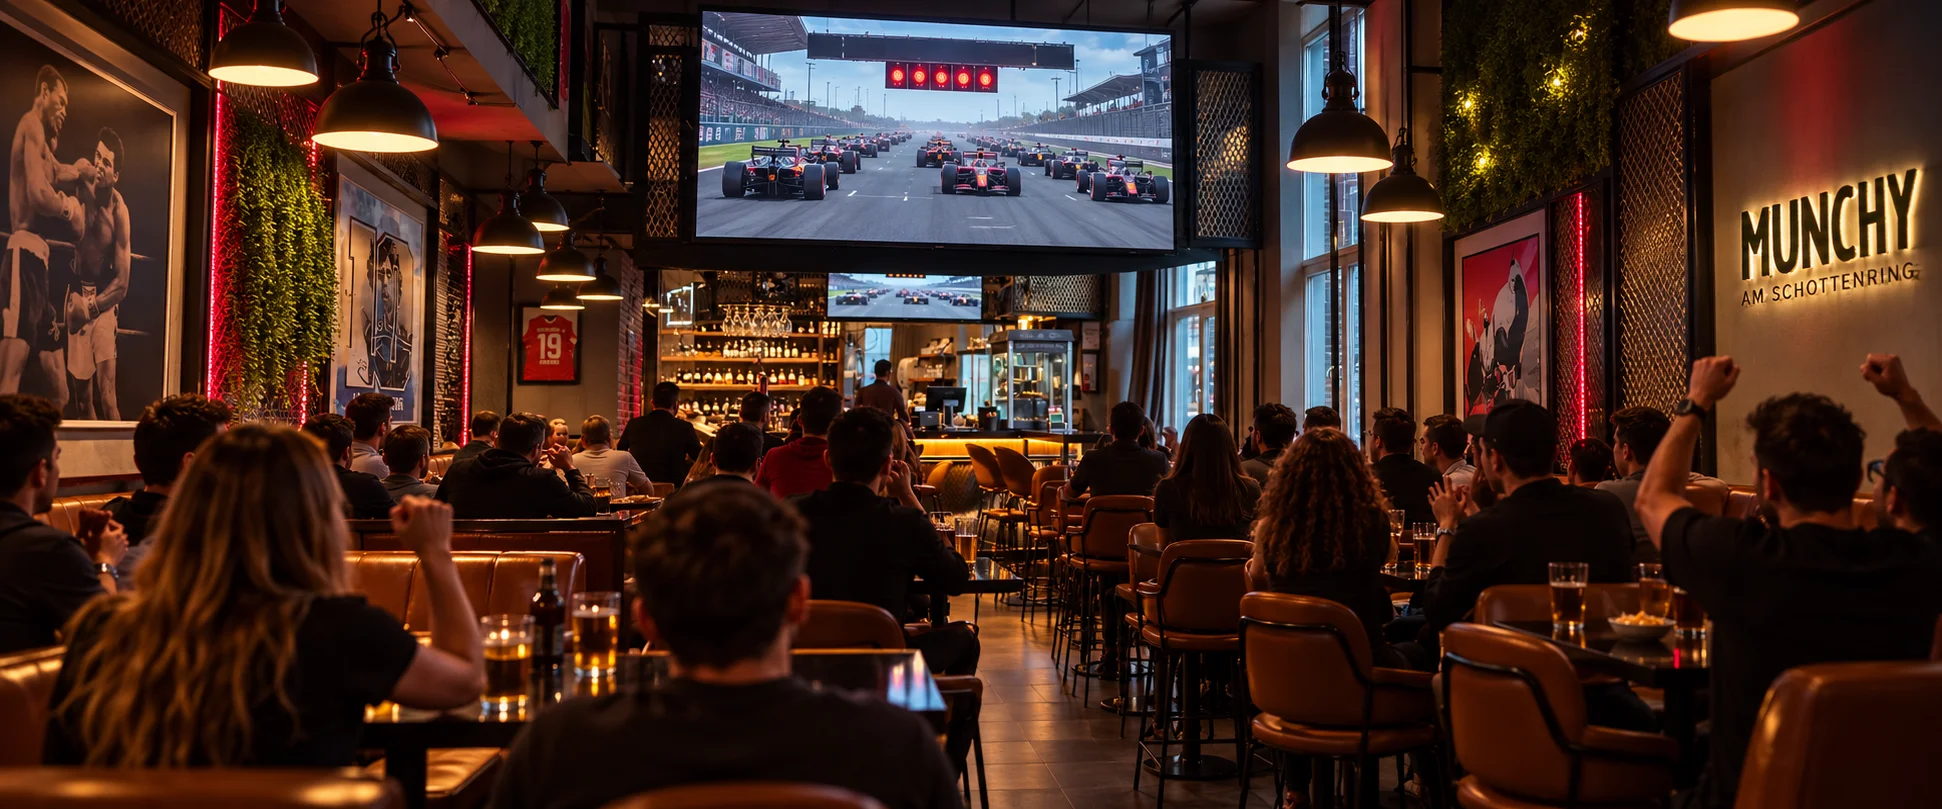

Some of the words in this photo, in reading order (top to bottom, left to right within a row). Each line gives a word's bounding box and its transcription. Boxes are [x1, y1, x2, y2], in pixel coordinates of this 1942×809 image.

[1741, 168, 1917, 280] MUNCHY
[1741, 288, 1764, 307] AM
[1772, 262, 1915, 302] SCHOTTENRING
[537, 333, 561, 360] 19
